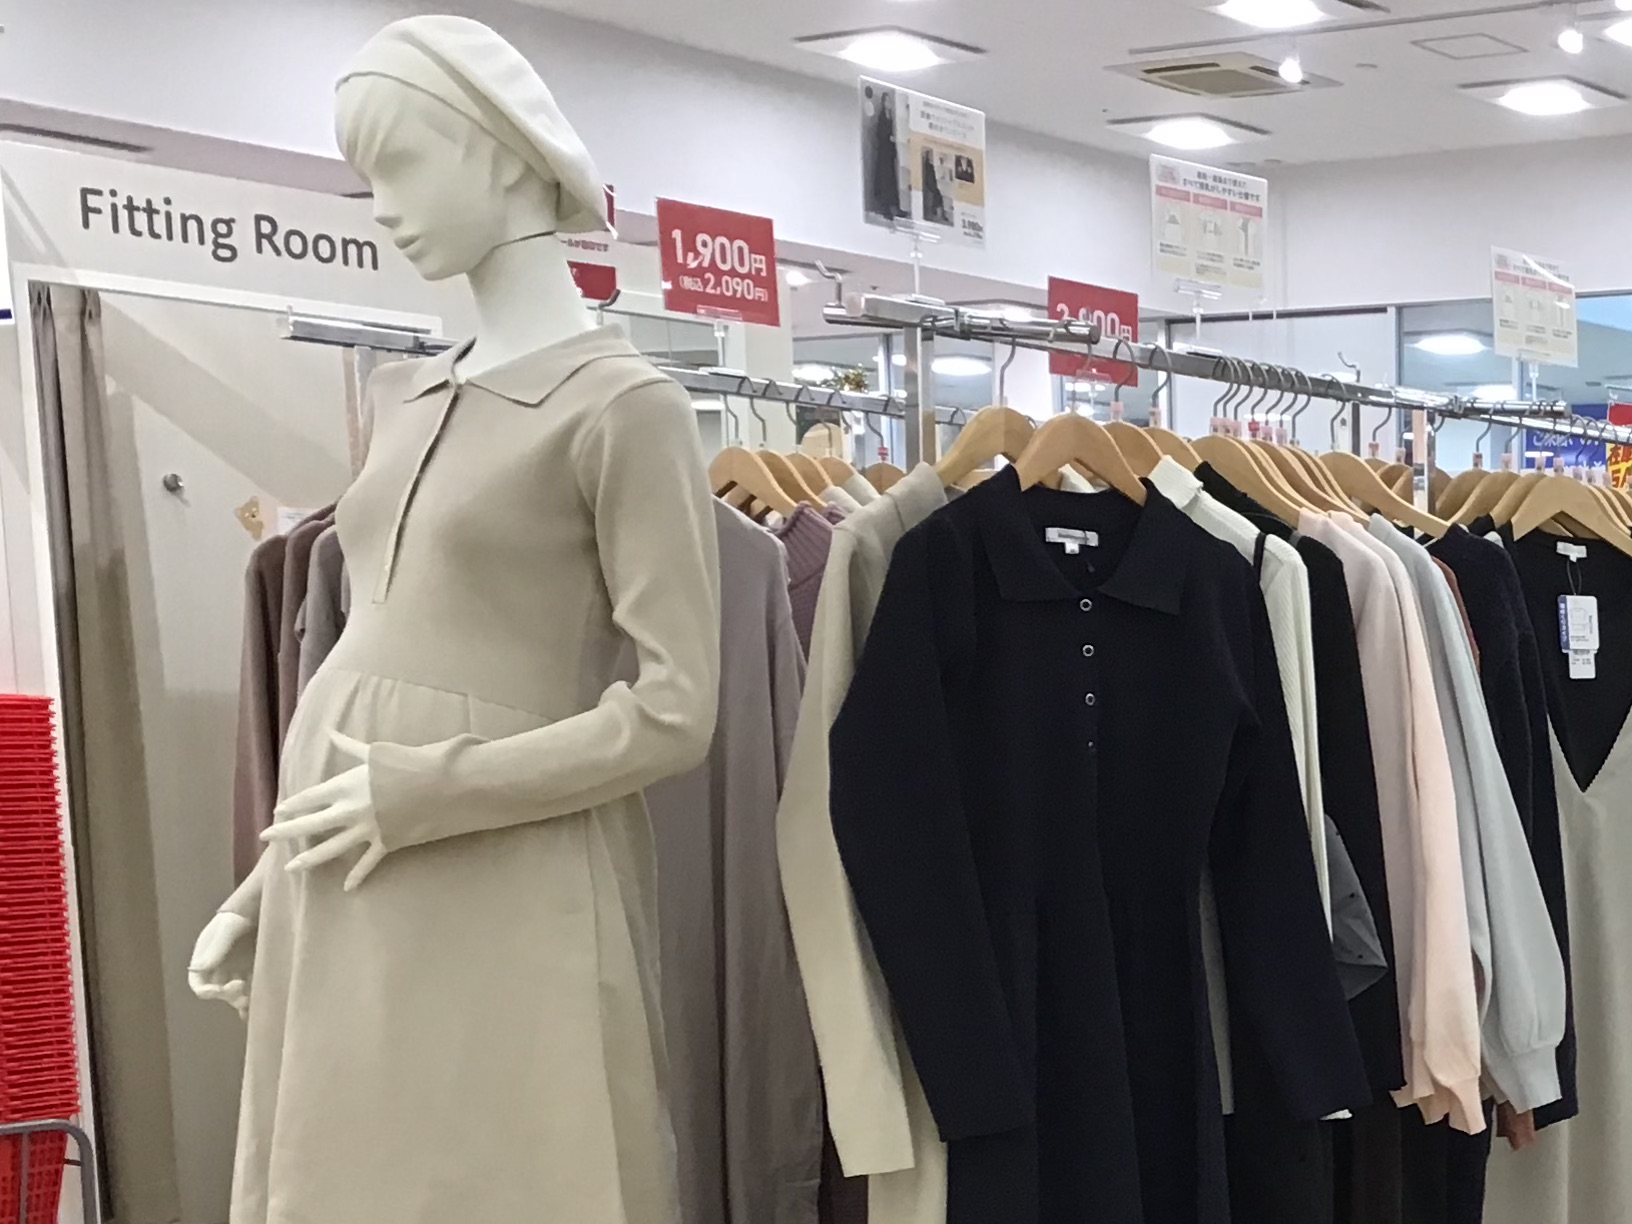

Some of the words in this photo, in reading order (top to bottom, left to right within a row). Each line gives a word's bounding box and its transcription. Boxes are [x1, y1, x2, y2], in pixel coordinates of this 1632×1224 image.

[79, 187, 239, 263] Fitting
[253, 213, 379, 271] Room
[671, 229, 767, 277] 1,900円
